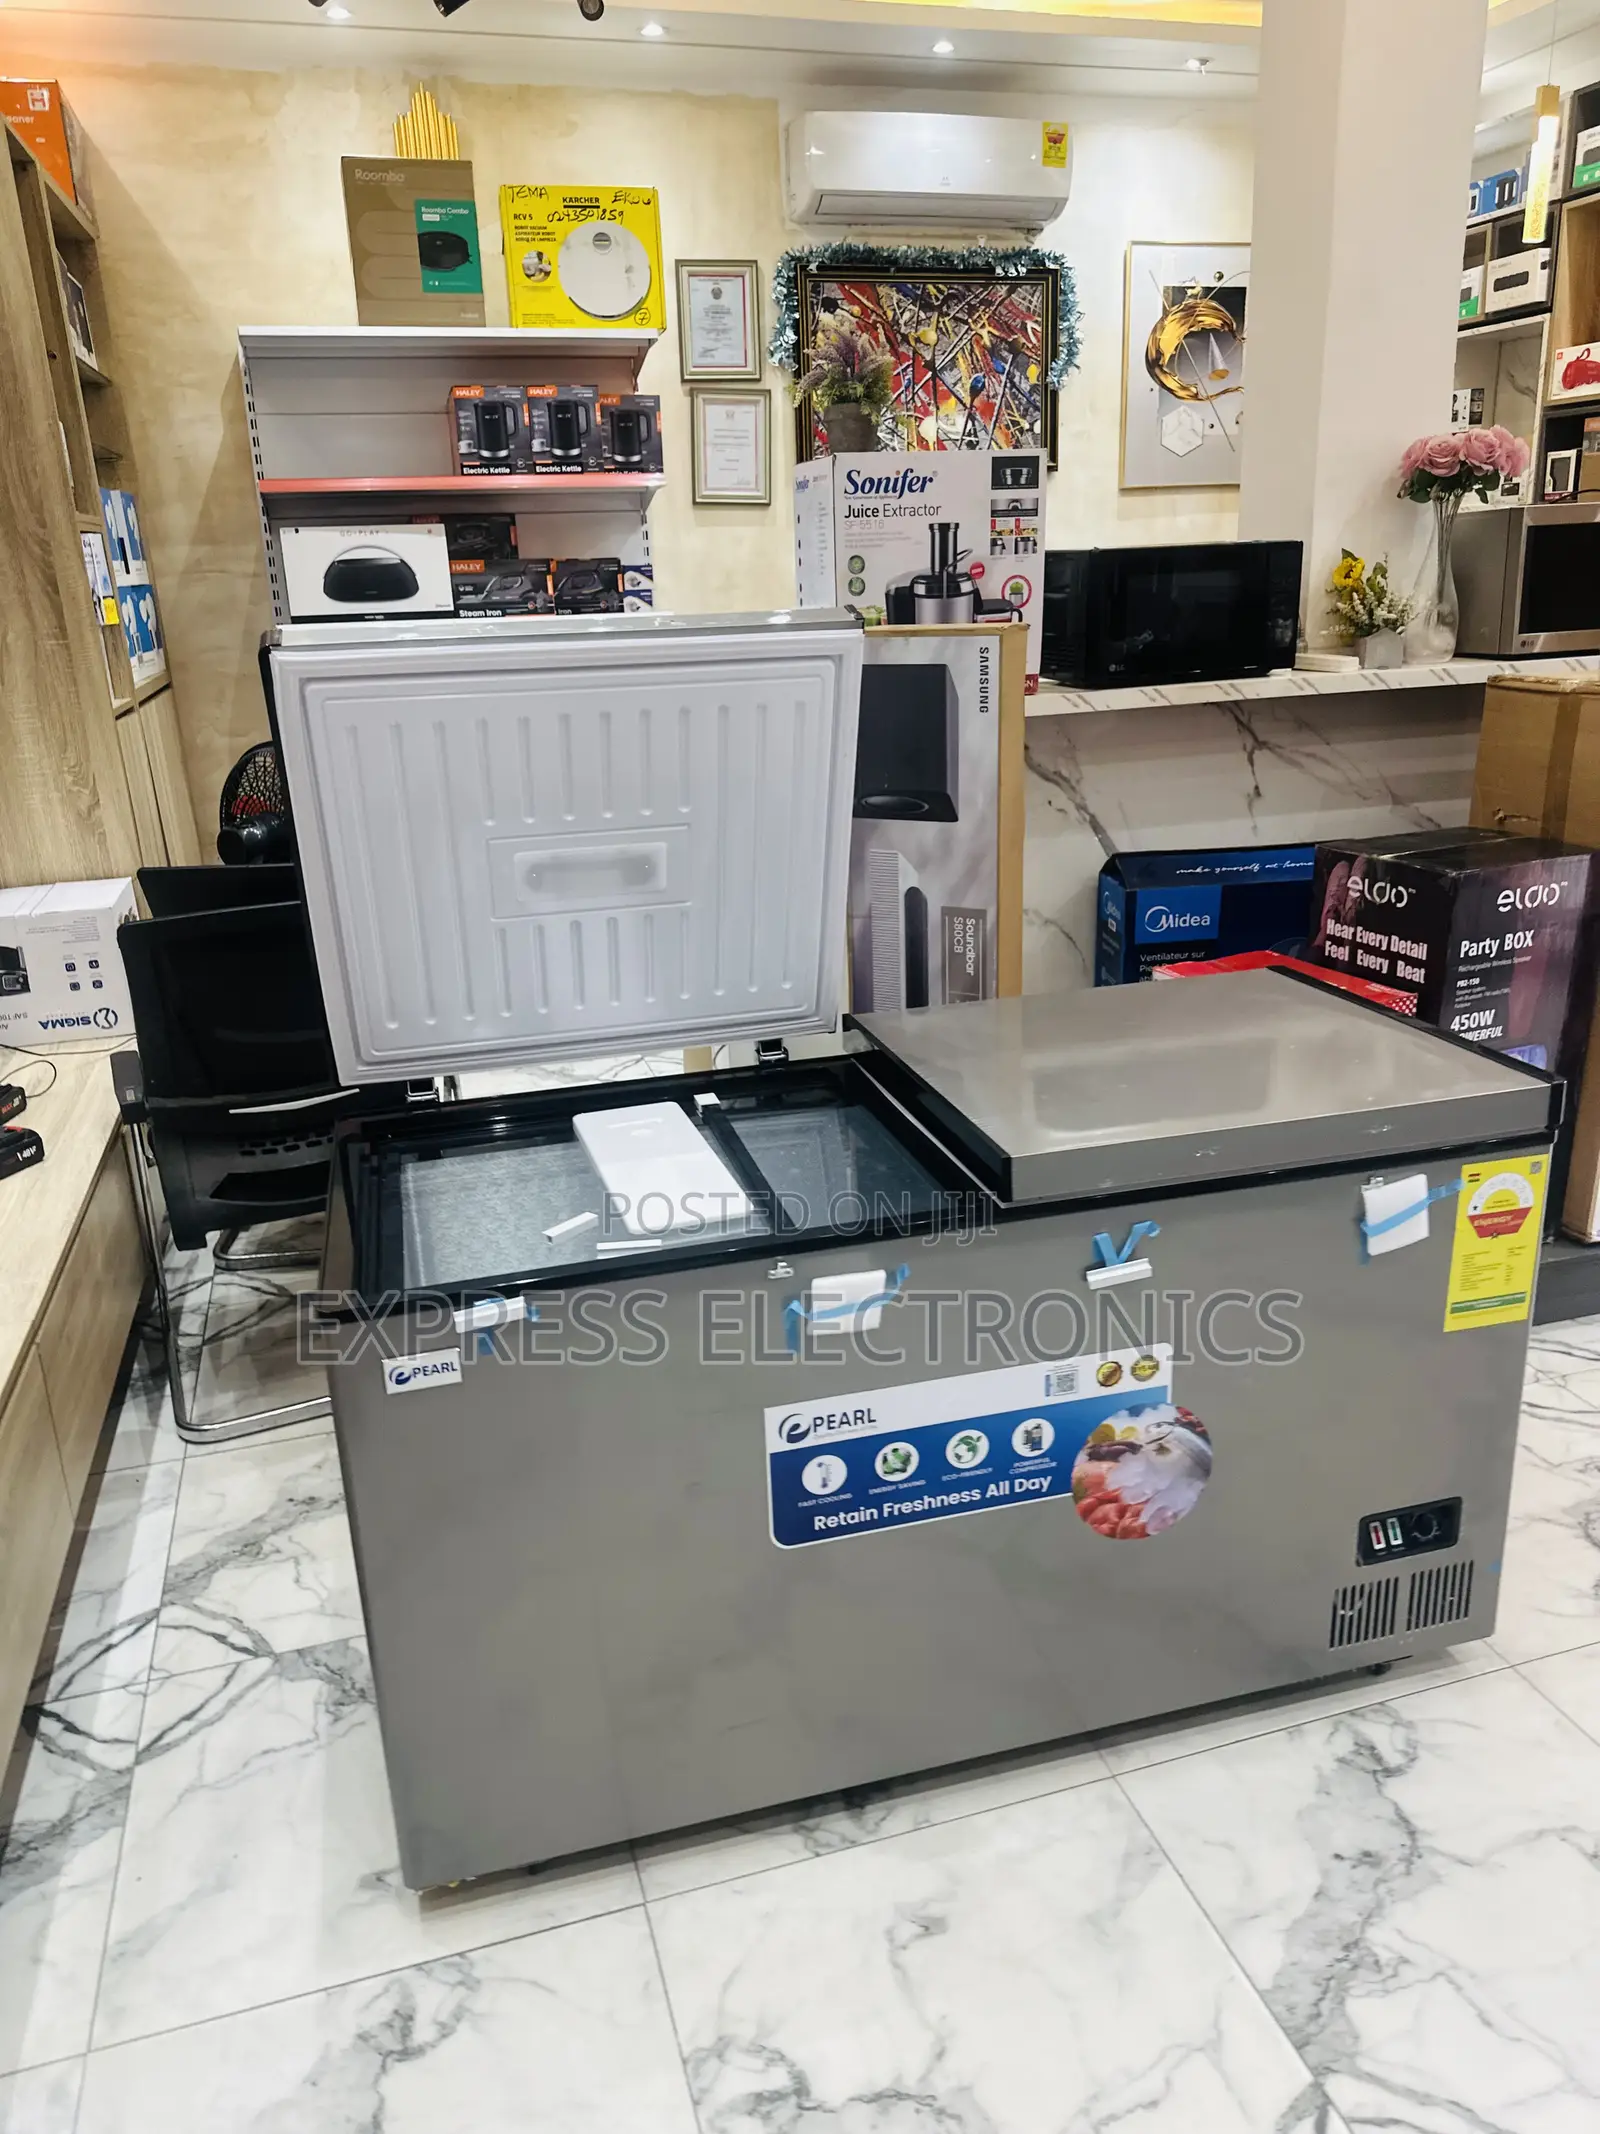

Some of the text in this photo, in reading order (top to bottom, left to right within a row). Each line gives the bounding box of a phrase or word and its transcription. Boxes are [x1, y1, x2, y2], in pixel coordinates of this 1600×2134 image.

[354, 169, 405, 182] Roomba
[507, 186, 549, 203] TEMA
[421, 206, 469, 215] Roomba Combo
[513, 213, 527, 221] RCV
[844, 468, 934, 500] Sonifer
[844, 503, 942, 519] Juice Extractor
[452, 563, 481, 571] HALEY
[459, 609, 502, 618] Steam Iron
[979, 646, 989, 713] SAMSUNG
[1176, 866, 1211, 874] make
[1153, 912, 1211, 930] Midea
[965, 917, 976, 976] Soundbar
[1327, 919, 1428, 961] Hear Every Detail
[1460, 929, 1535, 959] Party BOX
[1140, 951, 1206, 962] Ventilateur sur
[1325, 943, 1425, 984] Feel Every Beat
[38, 1015, 92, 1030] SIGMA
[1450, 1008, 1495, 1032] 450W
[412, 1360, 459, 1380] PEARL
[812, 1408, 877, 1433] PEARL
[942, 1467, 994, 1482] ECO-FRIENDLY
[868, 1479, 926, 1495] ENERGY SAVING
[798, 1493, 853, 1508] FAST COOLING
[813, 1475, 1052, 1531] Retain Freshness All Day
